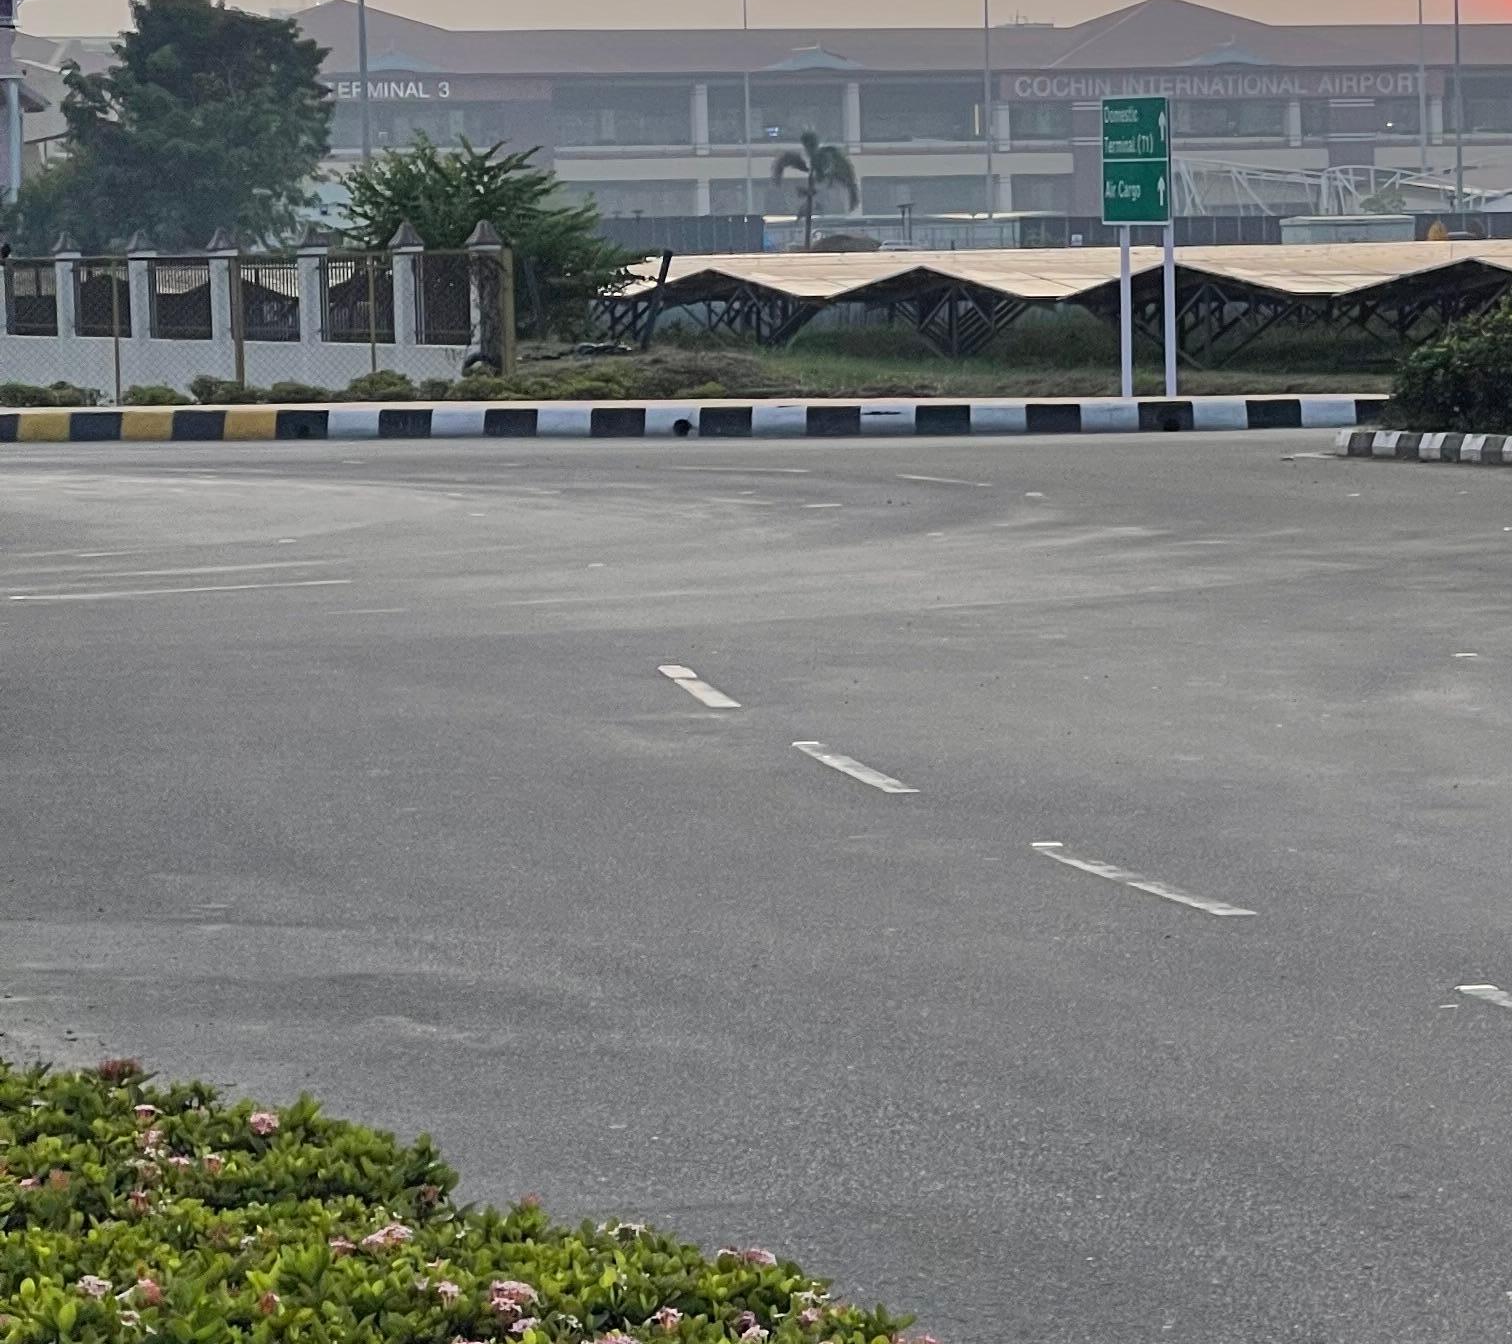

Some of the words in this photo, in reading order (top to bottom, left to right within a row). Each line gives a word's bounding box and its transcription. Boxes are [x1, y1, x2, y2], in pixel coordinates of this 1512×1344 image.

[438, 79, 451, 98] 3
[1015, 76, 1110, 97] COCHIN
[1122, 74, 1308, 96] INTERNATIONAL
[1104, 106, 1138, 123] Domestic
[1104, 136, 1135, 153] Terminal
[1105, 180, 1117, 198] Air
[1118, 180, 1142, 201] Cargo
